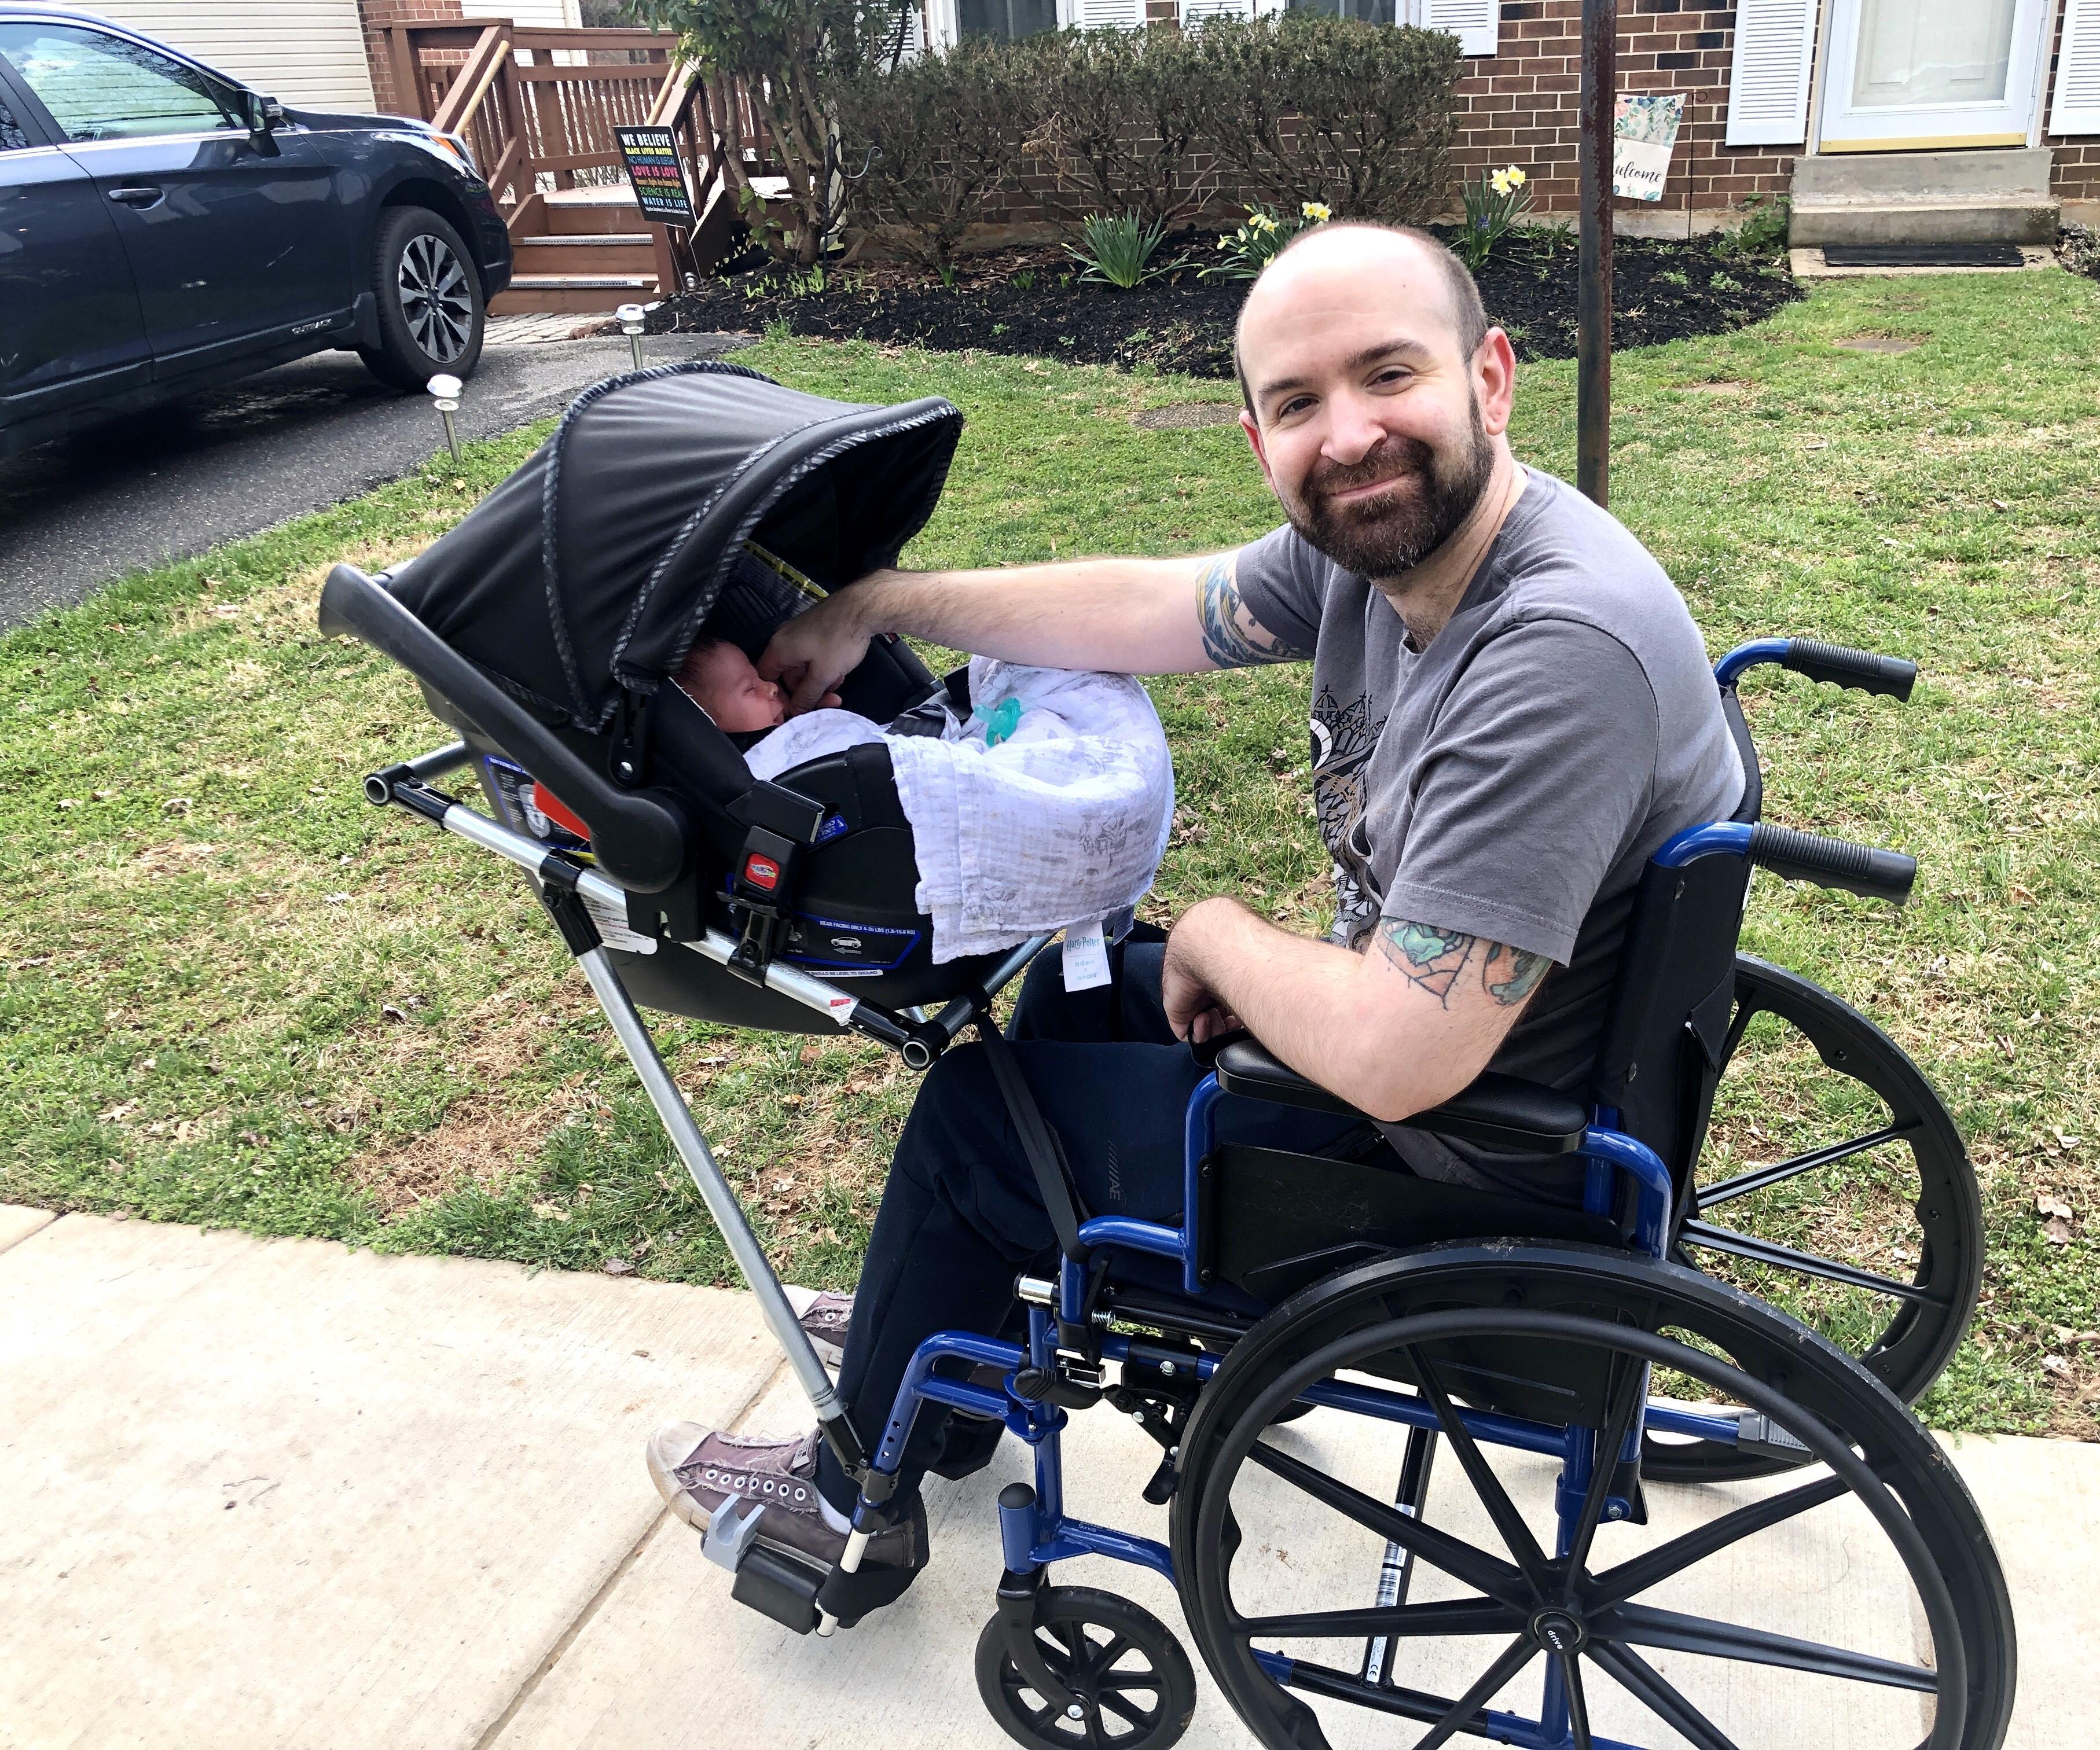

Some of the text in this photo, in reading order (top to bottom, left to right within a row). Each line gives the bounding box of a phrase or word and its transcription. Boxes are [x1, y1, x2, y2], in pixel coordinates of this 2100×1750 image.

[621, 134, 670, 146] WE BELIEVE
[641, 147, 655, 155] LIVES
[628, 156, 637, 164] NO
[637, 156, 656, 165] HUMAN
[632, 166, 679, 178] LOVE IS LOVE
[638, 186, 685, 198] SCIENCE IS REAL
[642, 197, 688, 208] WATER IS LIFE
[1066, 937, 1099, 951] Harry Potter
[1547, 1630, 1563, 1650] drive
